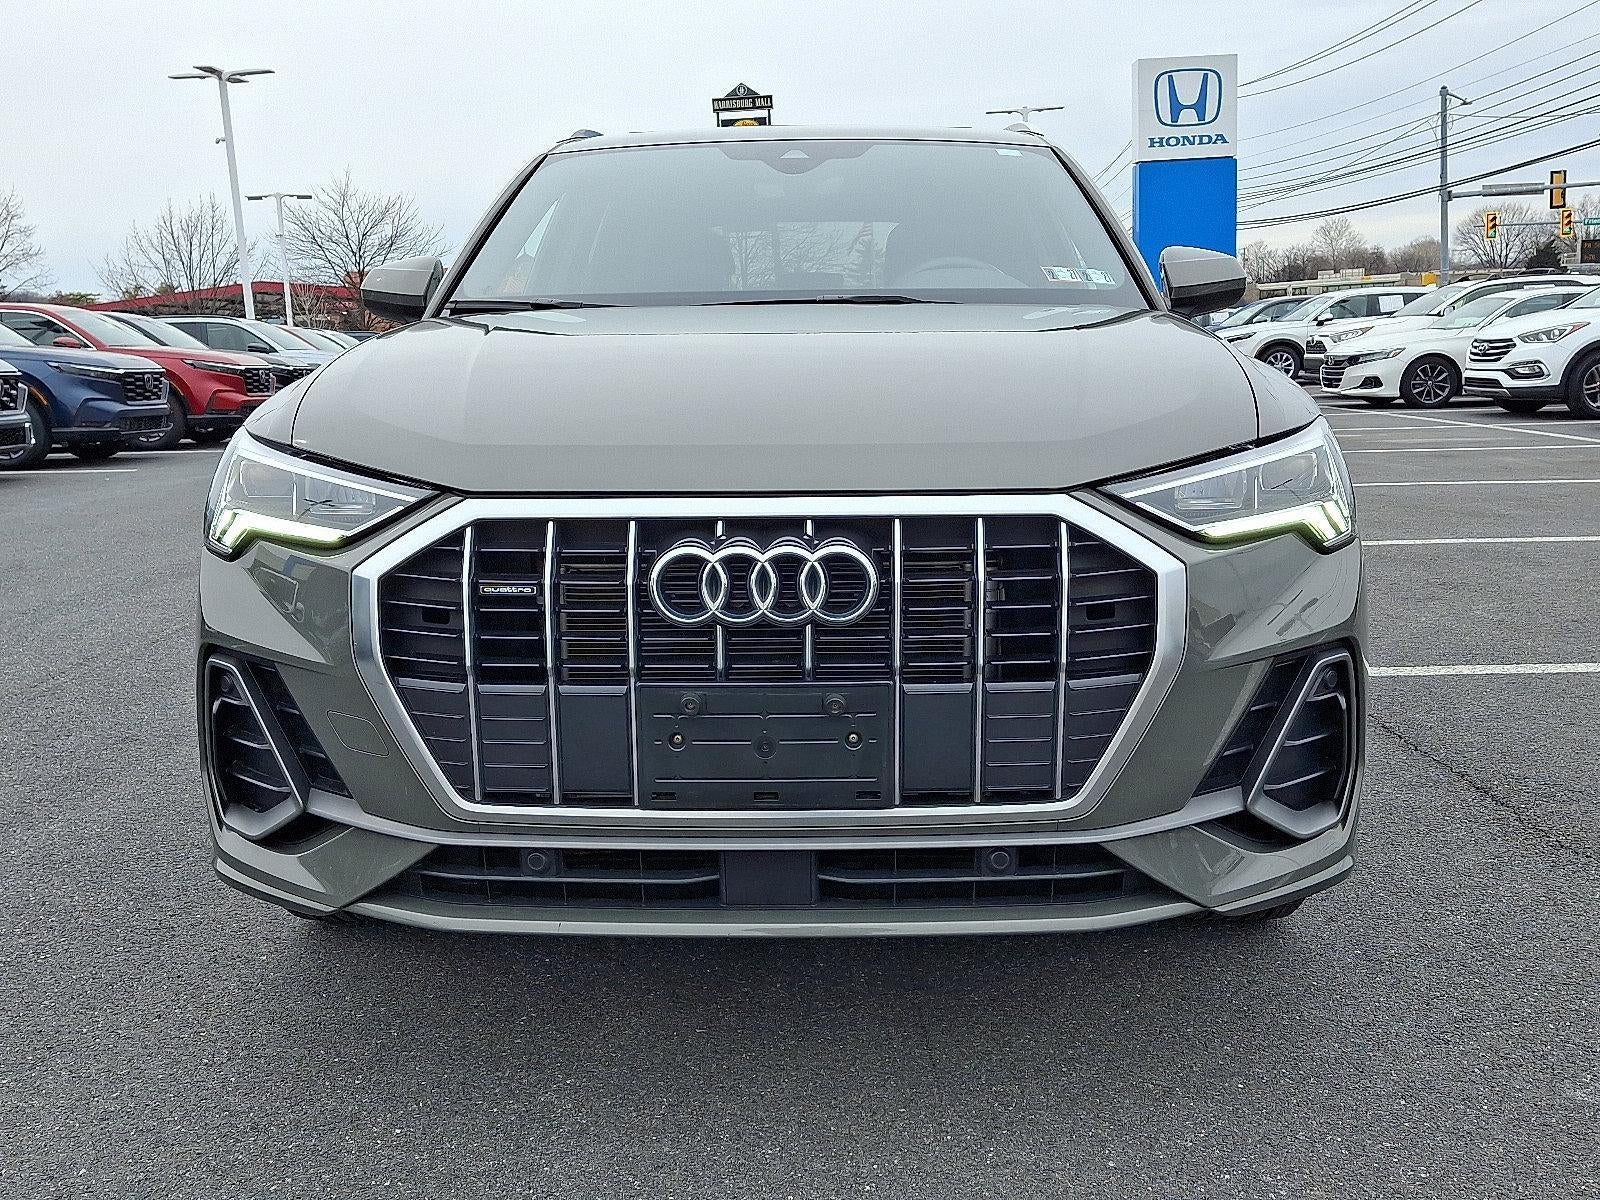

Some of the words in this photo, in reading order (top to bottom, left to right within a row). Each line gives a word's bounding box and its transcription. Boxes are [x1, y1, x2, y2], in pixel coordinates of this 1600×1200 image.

[713, 98, 753, 109] HARRISBURG
[755, 97, 772, 107] MALL
[1148, 133, 1229, 148] HONDA
